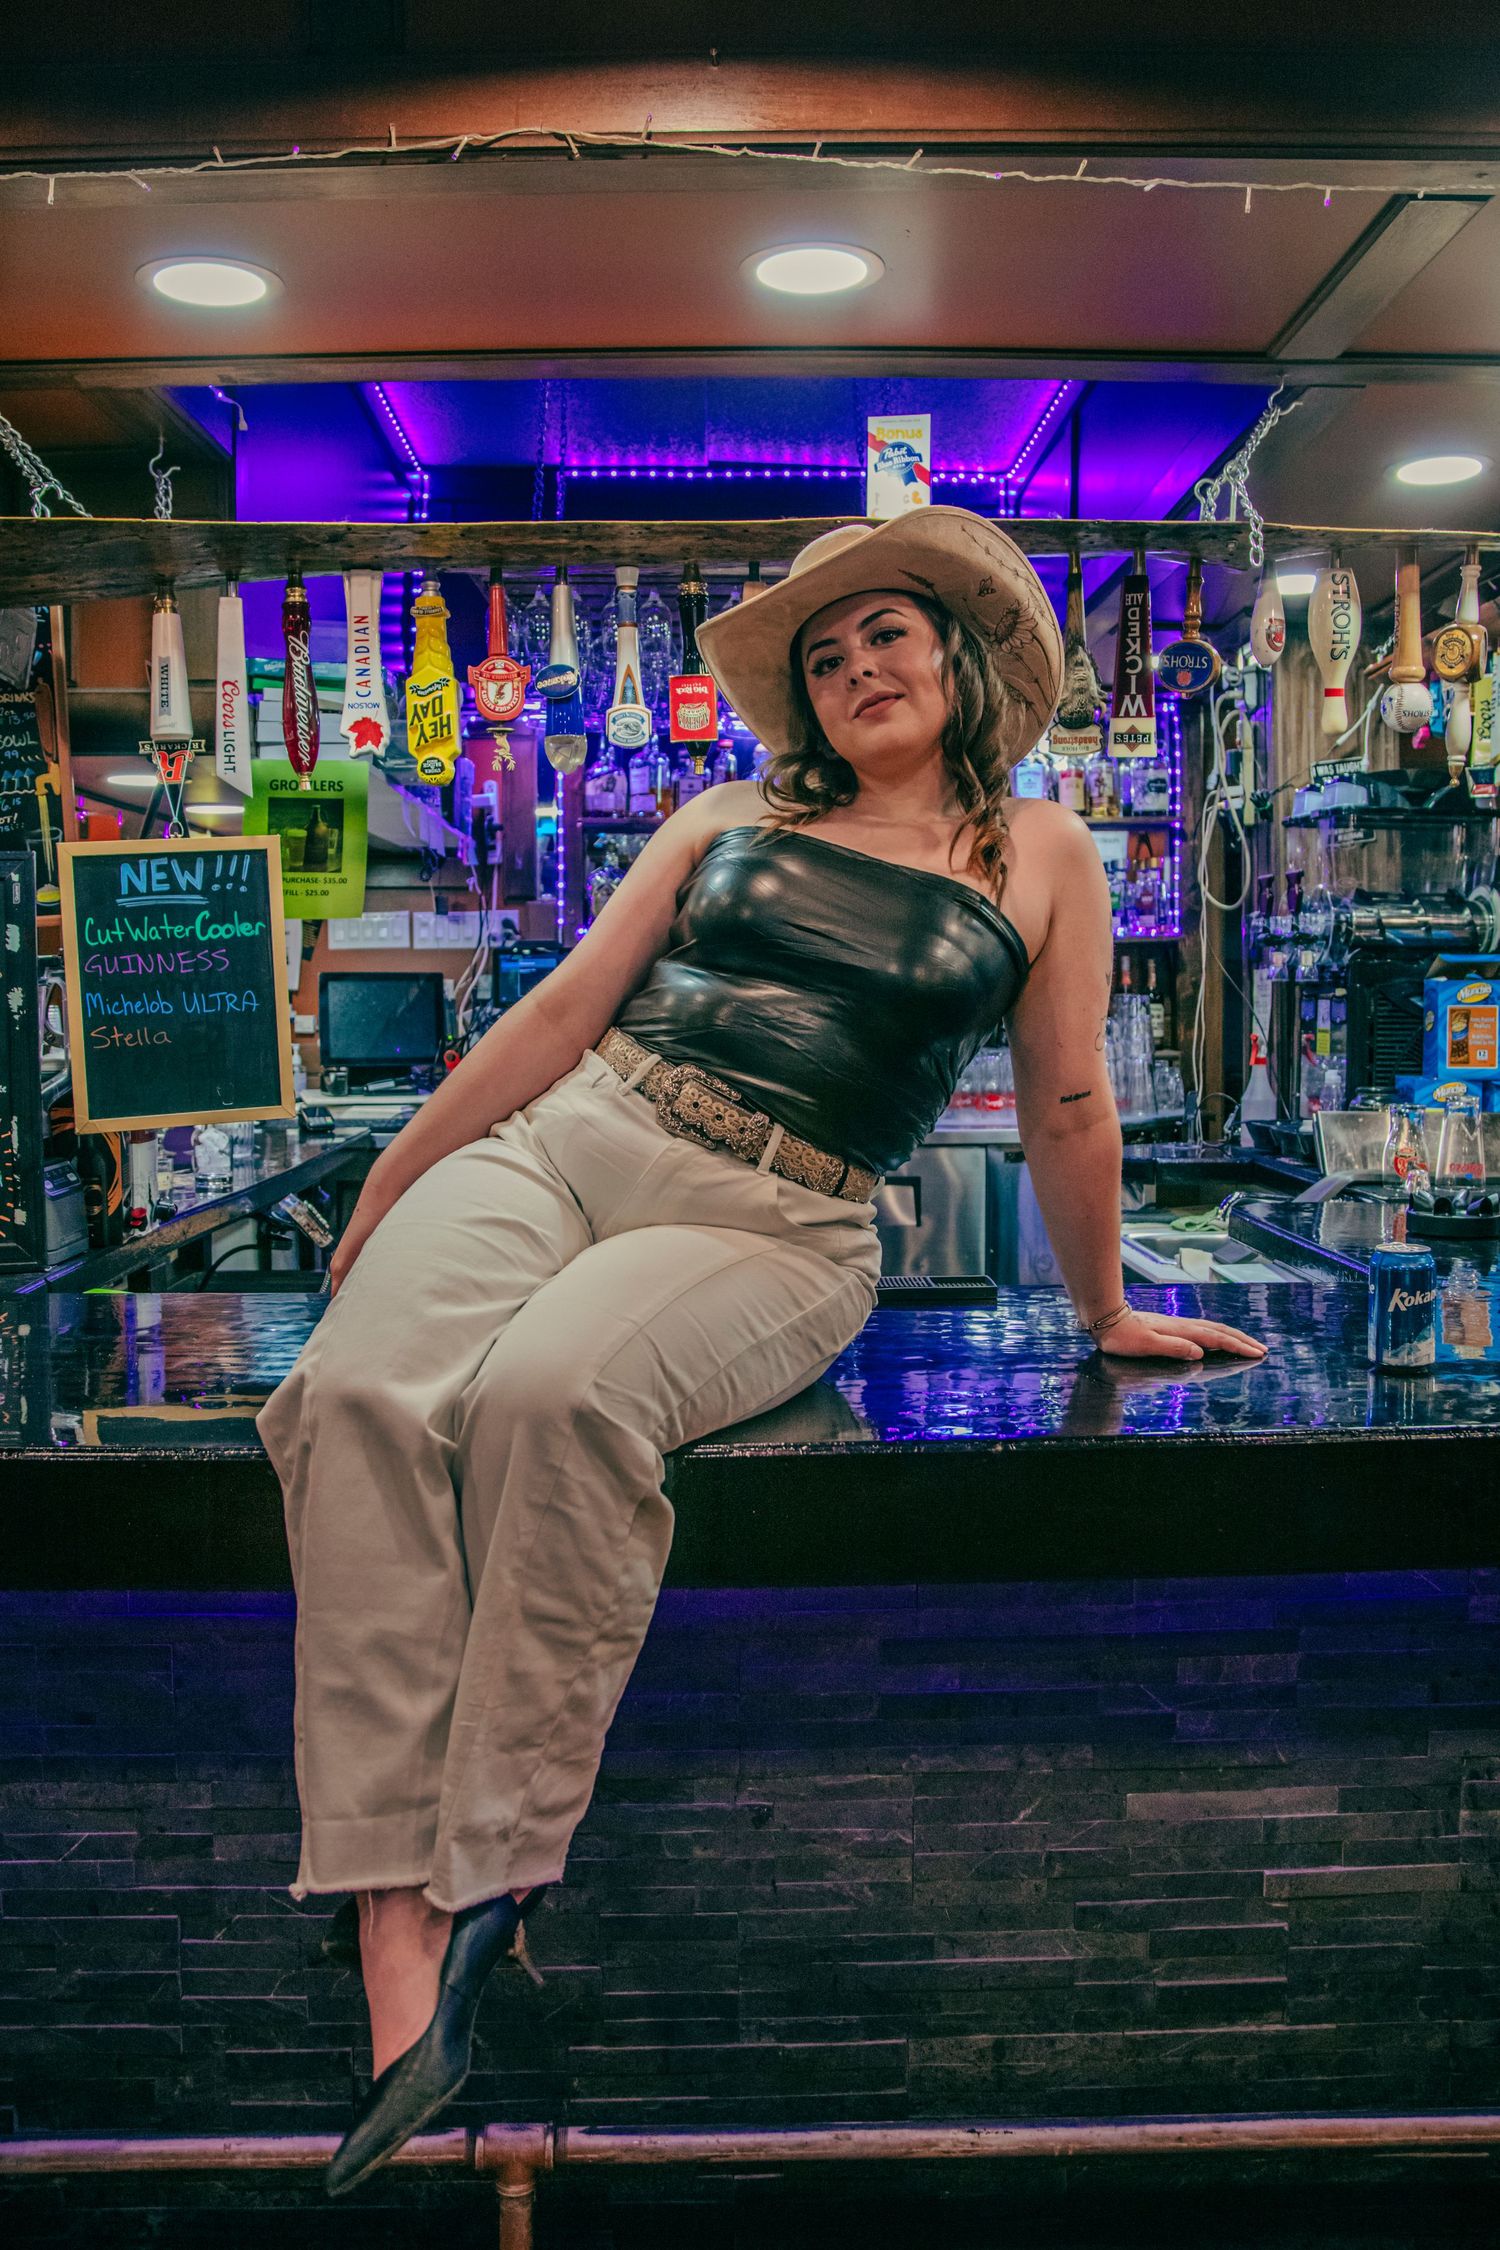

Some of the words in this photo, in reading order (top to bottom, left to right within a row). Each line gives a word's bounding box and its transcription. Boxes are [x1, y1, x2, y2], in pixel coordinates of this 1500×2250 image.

[875, 427, 923, 441] Bonus
[893, 454, 920, 465] Ribbon
[1125, 593, 1144, 605] ALE
[1330, 573, 1351, 661] STROH'S
[354, 615, 372, 698] CANADIAN
[1118, 607, 1147, 717] WICKED
[160, 664, 169, 708] WHITE
[288, 630, 312, 767] Budweiser
[222, 680, 240, 729] Coors
[409, 694, 443, 728] DAY
[416, 713, 452, 748] HEY
[1115, 733, 1150, 744] PETE'S
[223, 731, 236, 774] LIGHT
[1335, 761, 1363, 773] TAUGH
[269, 779, 344, 792] GROLERS
[85, 949, 230, 976] GUINNESS
[86, 990, 174, 1018] Michelob
[182, 990, 260, 1014] ULTRA
[90, 1026, 172, 1049] Stella
